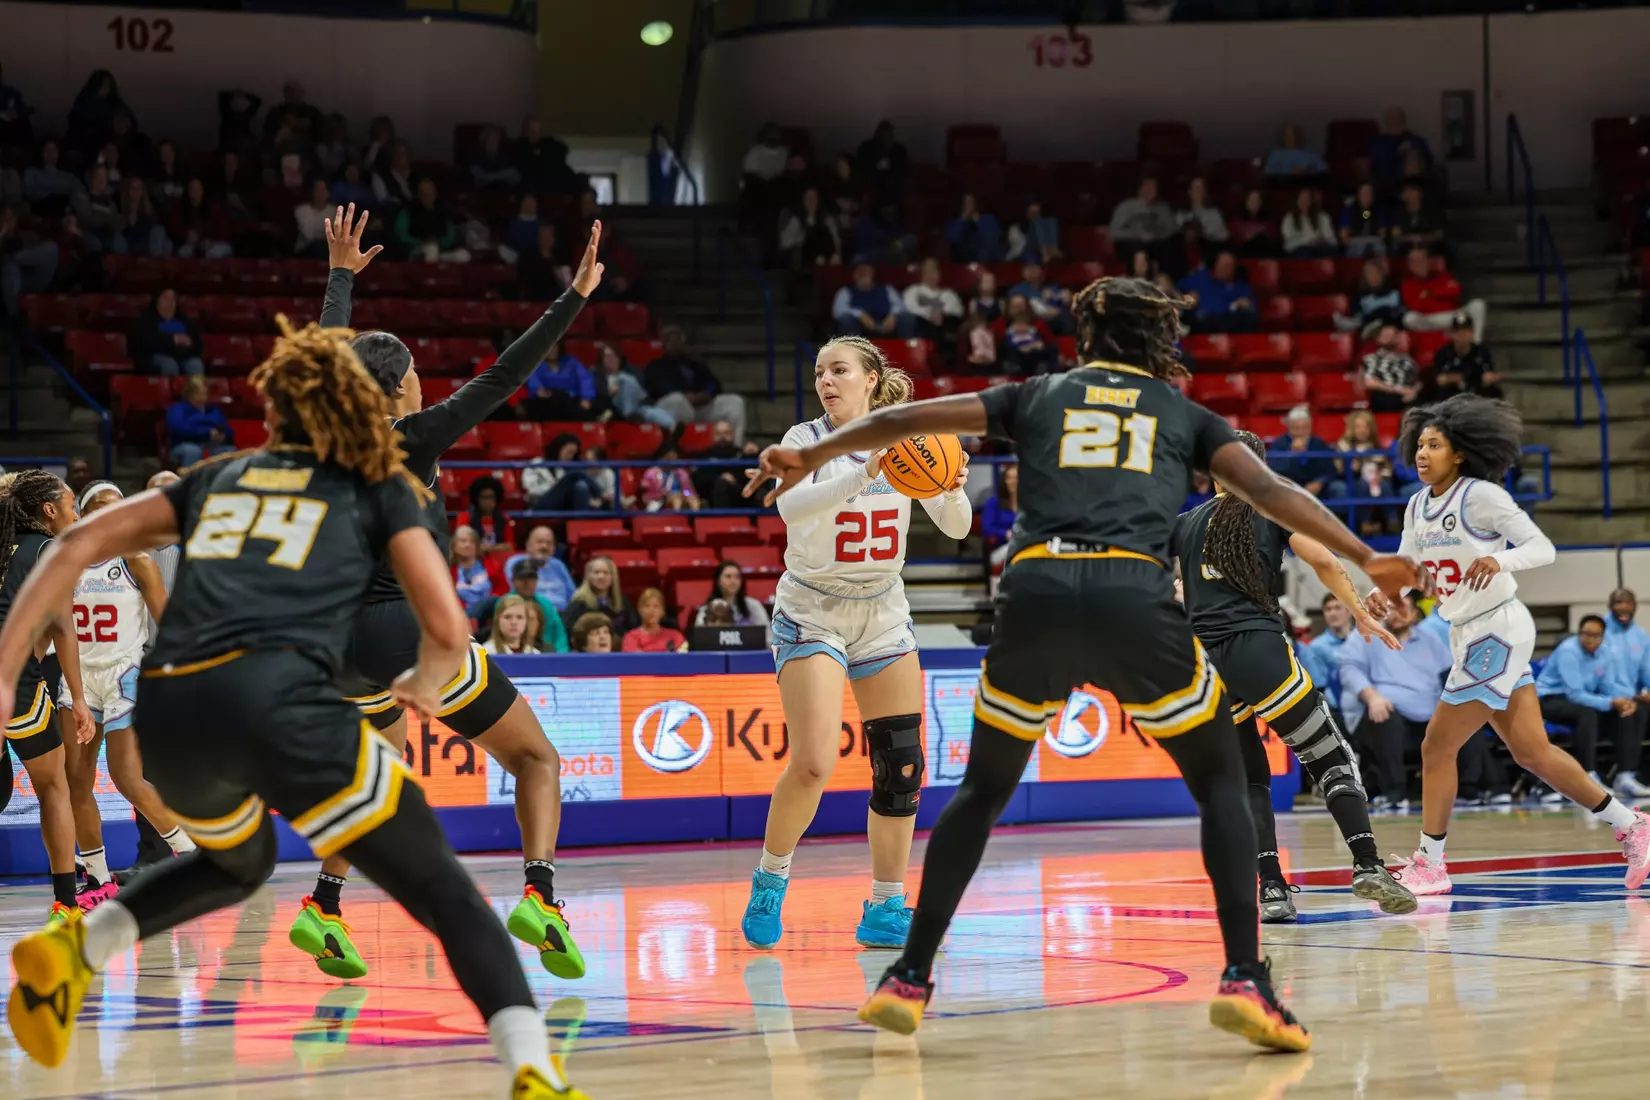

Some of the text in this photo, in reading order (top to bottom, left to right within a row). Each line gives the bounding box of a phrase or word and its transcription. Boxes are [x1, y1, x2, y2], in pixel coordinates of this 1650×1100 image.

[106, 15, 174, 53] 102
[1027, 33, 1092, 68] 103
[910, 435, 938, 470] lson
[1059, 408, 1158, 474] 21
[185, 491, 329, 571] 24
[834, 508, 899, 563] 25
[72, 604, 118, 642] 22
